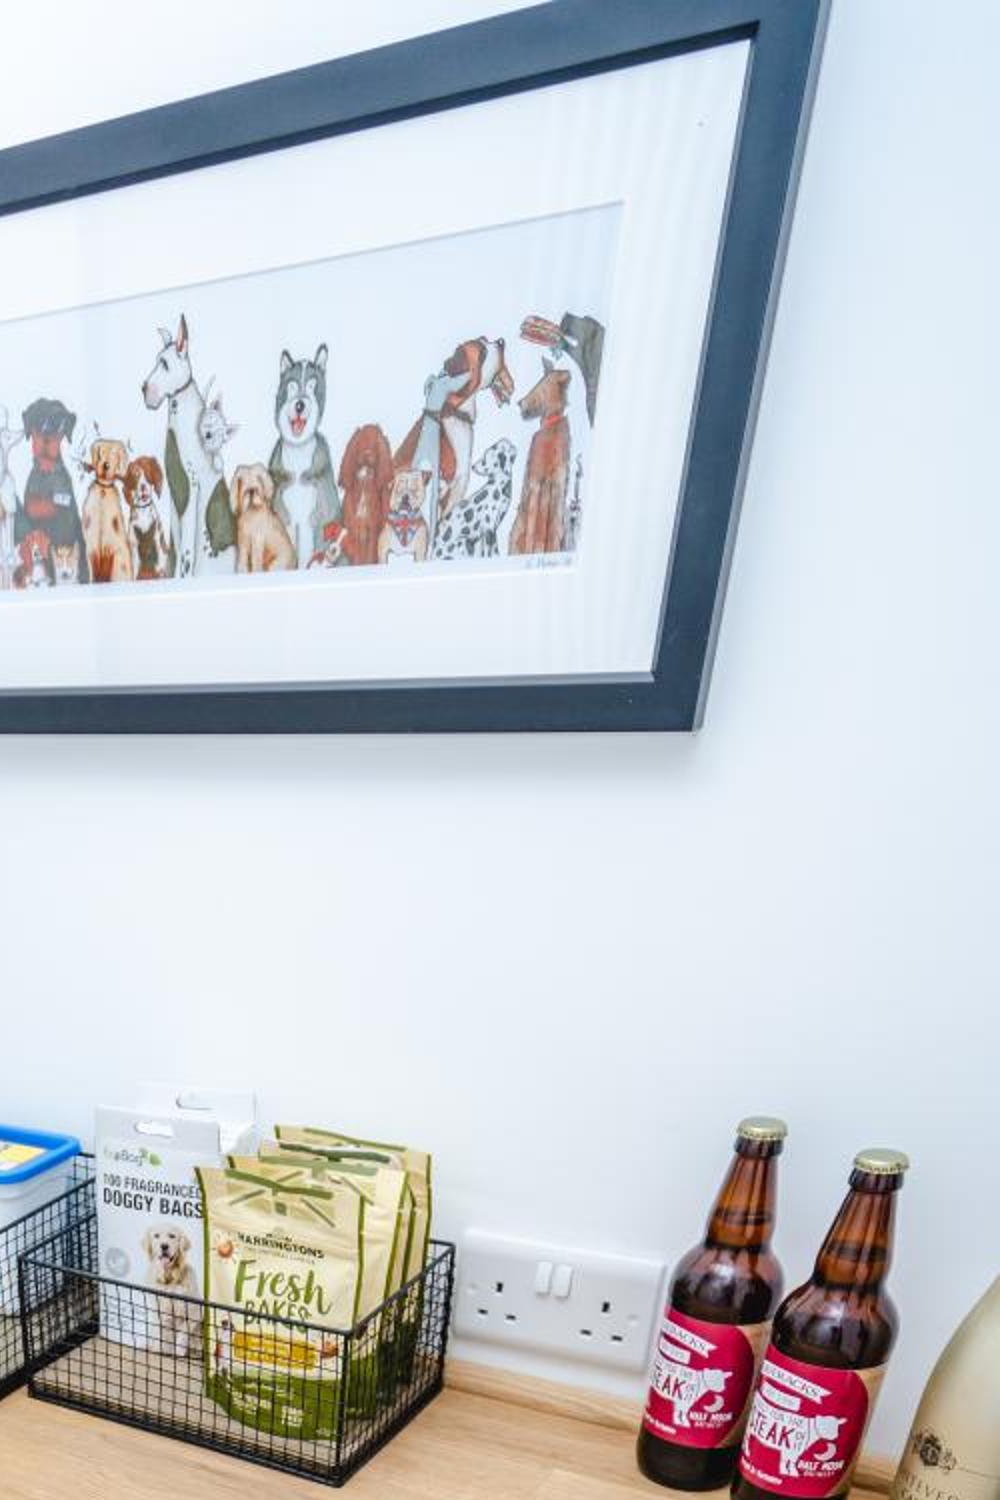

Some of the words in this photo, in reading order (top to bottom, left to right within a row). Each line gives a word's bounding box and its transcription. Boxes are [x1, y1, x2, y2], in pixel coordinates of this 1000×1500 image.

[103, 1187, 154, 1212] DOGGY
[159, 1198, 204, 1219] BAGS
[238, 1232, 325, 1259] HARRINGTONS
[234, 1259, 332, 1315] Fresh
[797, 1460, 820, 1471] HALF
